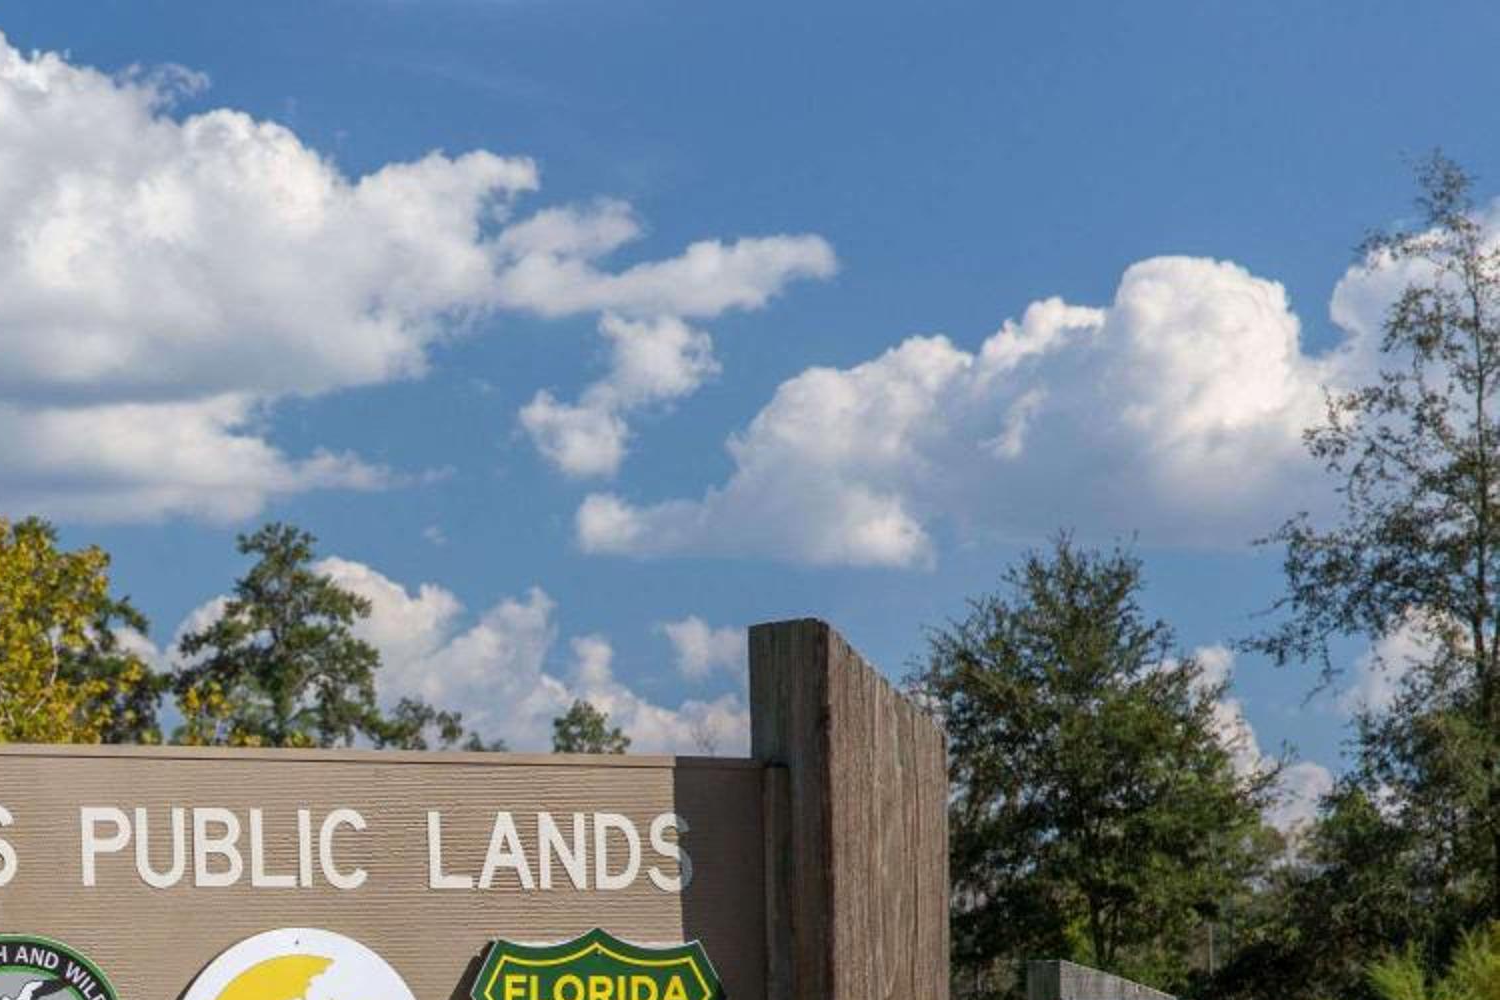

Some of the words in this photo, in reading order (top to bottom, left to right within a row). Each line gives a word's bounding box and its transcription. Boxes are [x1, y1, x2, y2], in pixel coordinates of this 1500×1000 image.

[80, 807, 367, 889] PUBLIC
[427, 811, 692, 891] LANDS
[14, 946, 60, 969] AND
